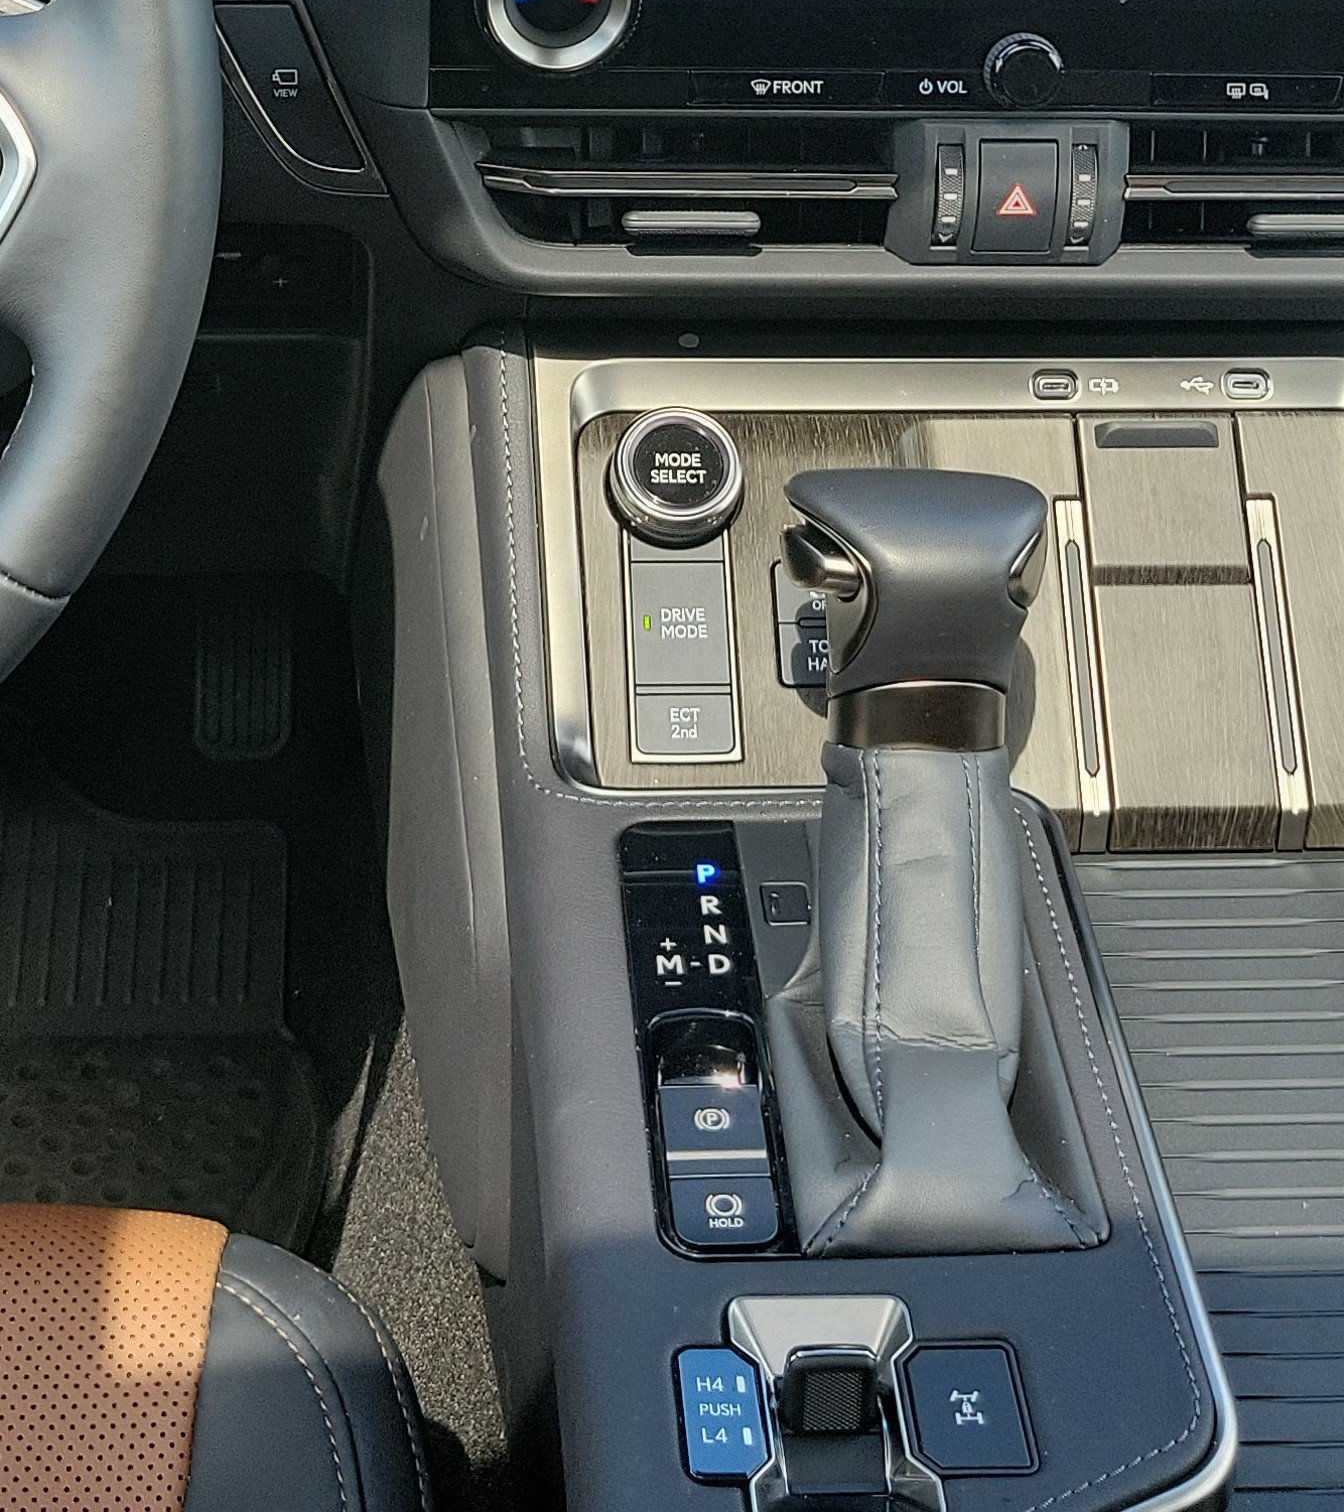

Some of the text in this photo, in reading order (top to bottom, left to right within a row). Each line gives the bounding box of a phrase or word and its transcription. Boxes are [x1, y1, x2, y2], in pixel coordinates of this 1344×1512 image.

[272, 88, 297, 98] VIEW
[772, 79, 824, 95] FRONT
[936, 80, 968, 94] VOL
[655, 453, 701, 468] MODE
[650, 468, 706, 484] SELECT
[660, 607, 706, 622] DRIVE
[660, 623, 708, 639] MODE
[808, 639, 829, 653] TO
[808, 656, 828, 671] HA
[669, 707, 700, 723] ECT
[670, 723, 698, 739] 2nd
[696, 864, 715, 884] P
[700, 895, 722, 915] R
[703, 924, 728, 944] N
[656, 953, 731, 975] M D
[709, 1218, 744, 1228] HOLD
[696, 1376, 723, 1392] H4
[699, 1403, 741, 1416] PUSH
[701, 1427, 727, 1443] L4
